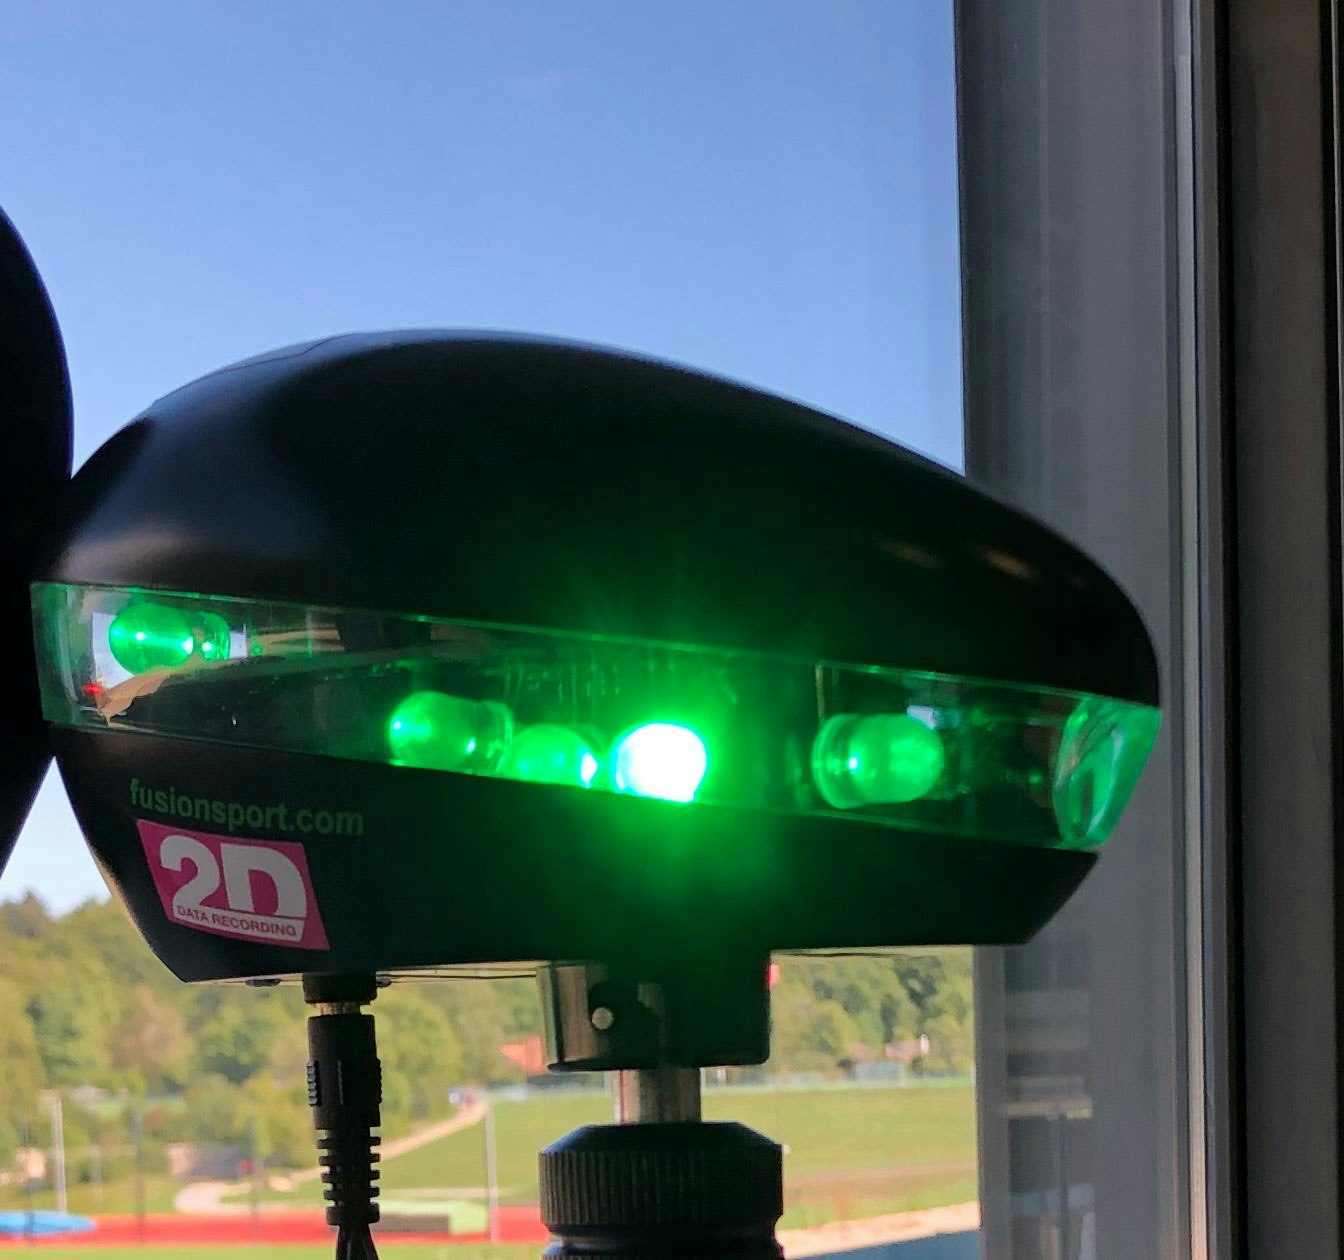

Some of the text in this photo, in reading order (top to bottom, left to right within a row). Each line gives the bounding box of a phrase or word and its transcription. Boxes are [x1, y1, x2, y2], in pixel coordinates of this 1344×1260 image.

[130, 778, 364, 835] fusionsport.com
[160, 835, 307, 919] 2D
[176, 904, 298, 938] DATA RECORDING
